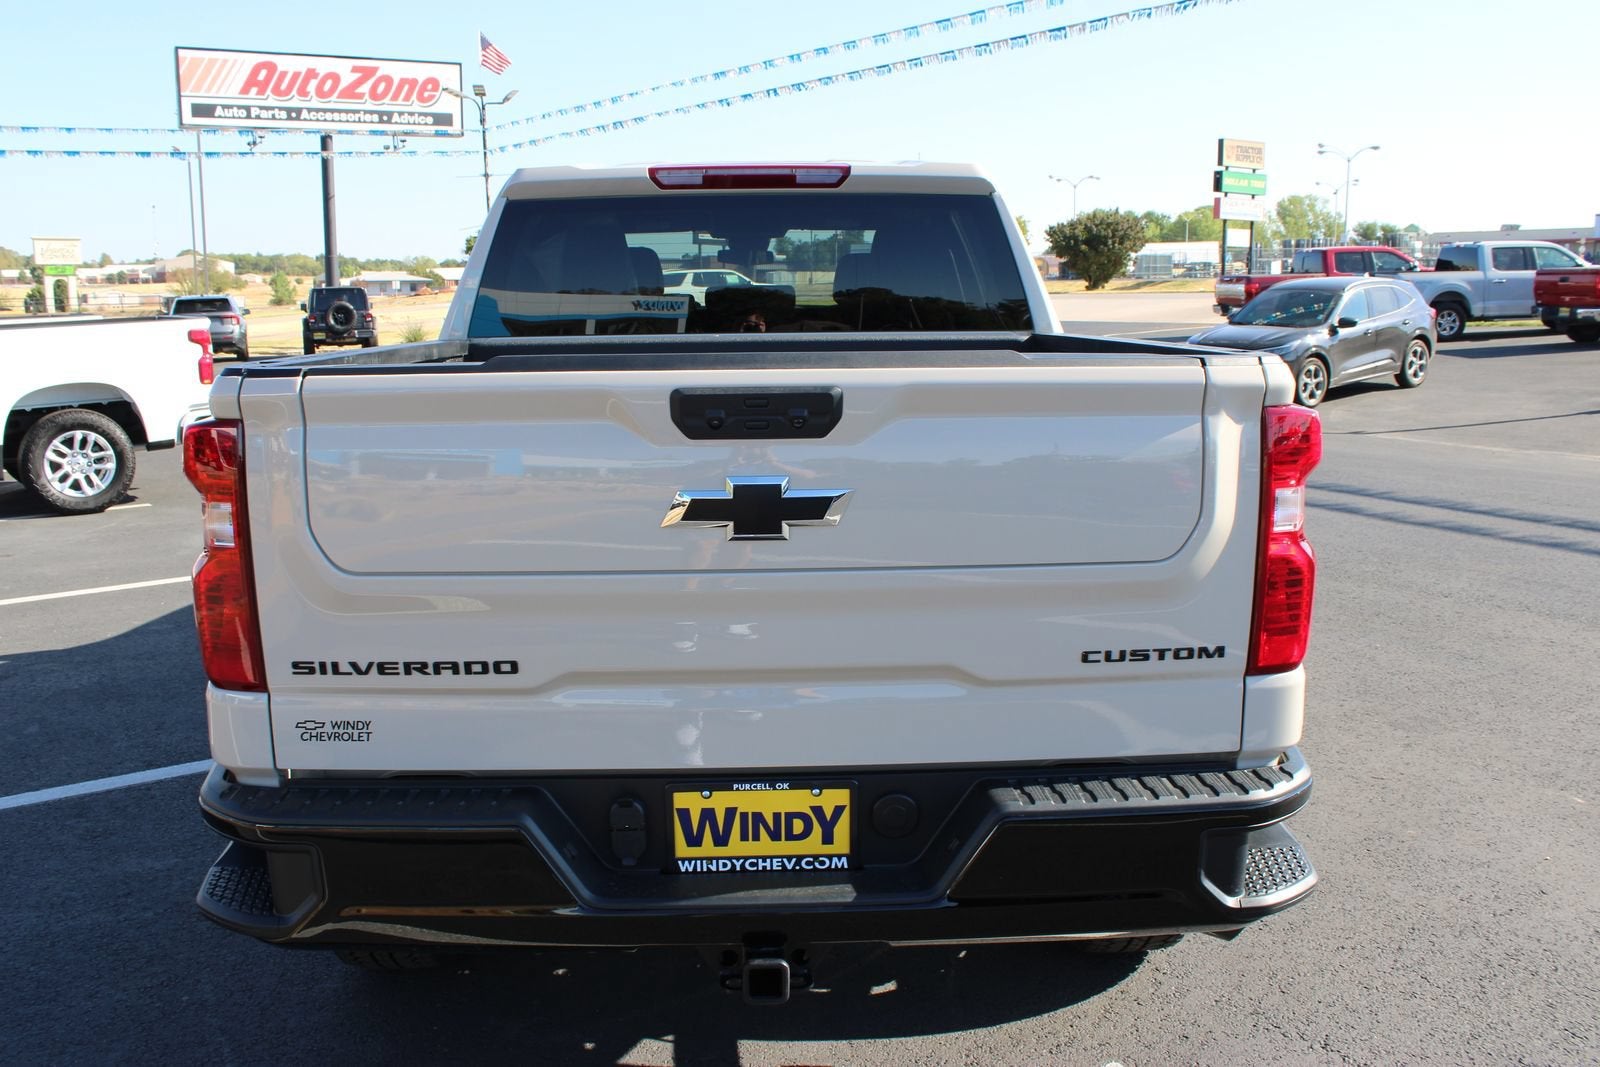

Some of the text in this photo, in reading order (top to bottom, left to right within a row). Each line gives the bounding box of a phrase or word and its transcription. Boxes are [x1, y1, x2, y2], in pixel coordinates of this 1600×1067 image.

[239, 60, 440, 104] AutoZone
[214, 105, 433, 125] Auto Parts Accessories Advice
[1081, 645, 1226, 664] CUSTOM
[291, 660, 519, 676] SILVERADO
[330, 720, 373, 731] WINDY
[300, 731, 373, 742] CHEVROLET
[733, 782, 790, 791] PURCELL, OK
[675, 804, 848, 848] WINDY
[677, 856, 848, 873] WINDYCHEV.COM
